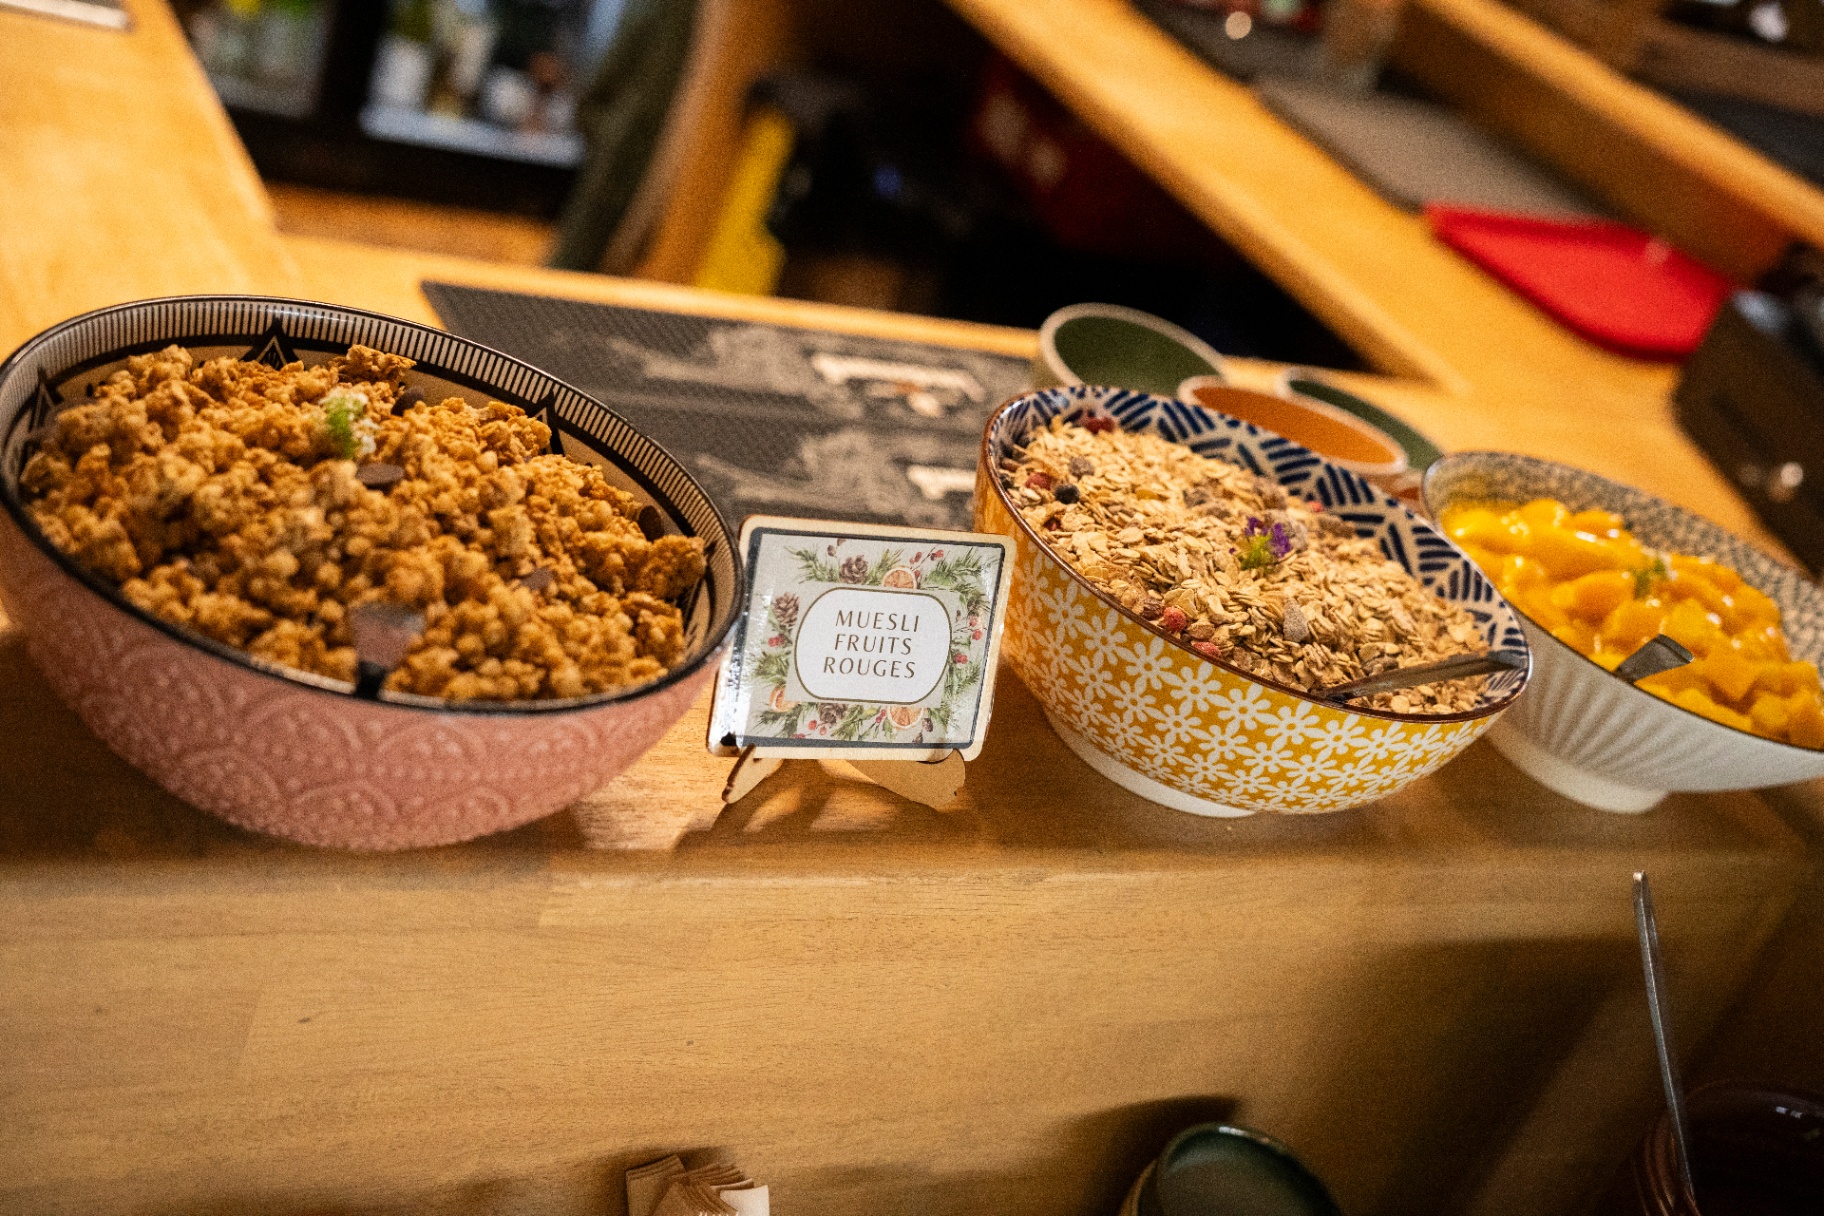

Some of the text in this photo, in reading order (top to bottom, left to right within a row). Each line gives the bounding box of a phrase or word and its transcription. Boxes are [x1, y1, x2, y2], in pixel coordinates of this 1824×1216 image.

[835, 609, 919, 632] MUESLI
[834, 633, 912, 655] FRUITS
[823, 656, 916, 679] ROUGES
